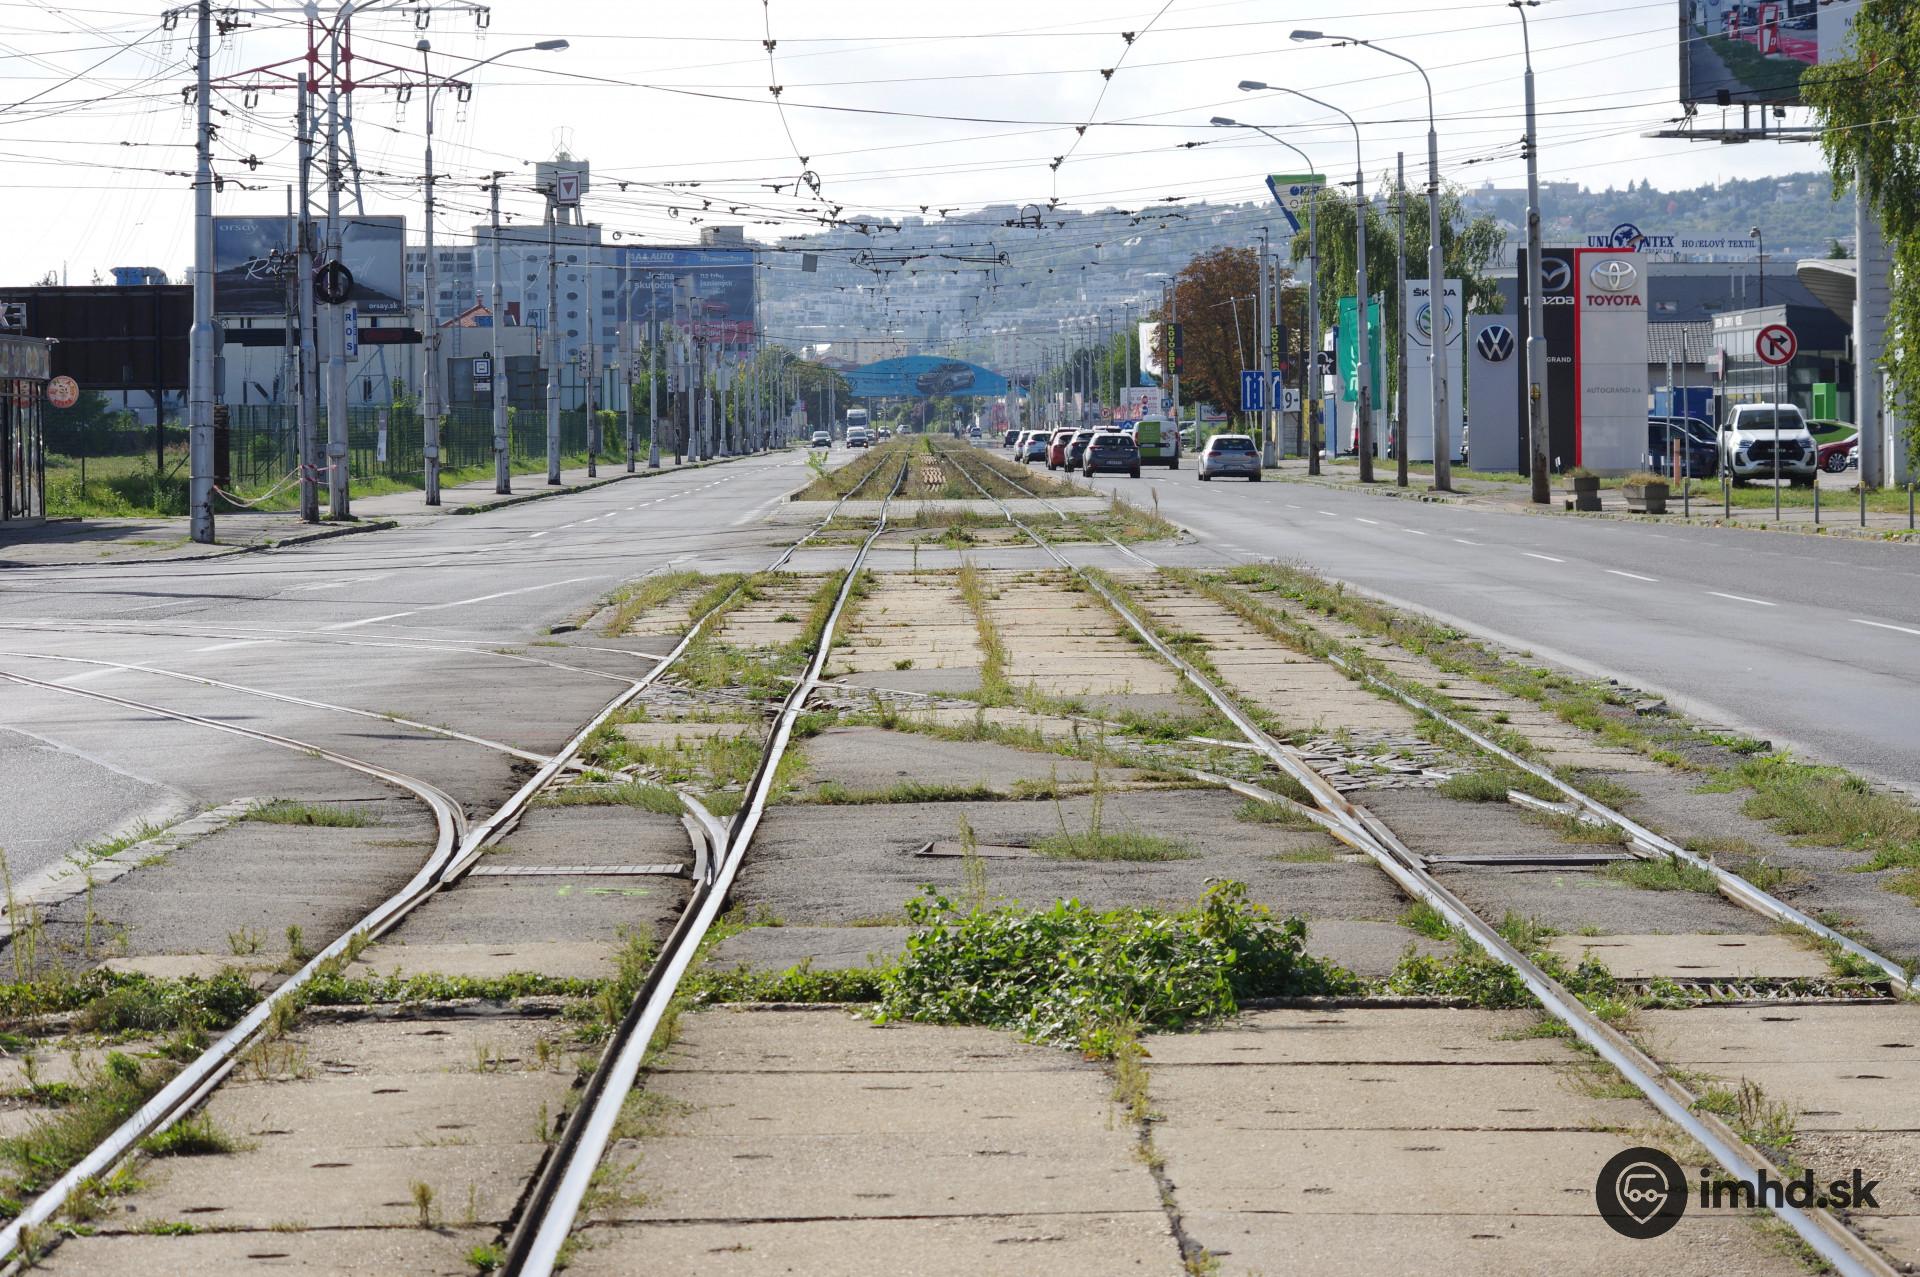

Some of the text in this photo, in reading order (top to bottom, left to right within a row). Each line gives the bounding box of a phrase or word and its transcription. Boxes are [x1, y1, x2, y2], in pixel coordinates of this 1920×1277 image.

[219, 224, 259, 235] orsay
[1727, 240, 1757, 248] TEXTIL
[1413, 287, 1457, 297] ŠKA
[1586, 294, 1642, 306] TOYOTA
[368, 301, 398, 311] orsay.sk
